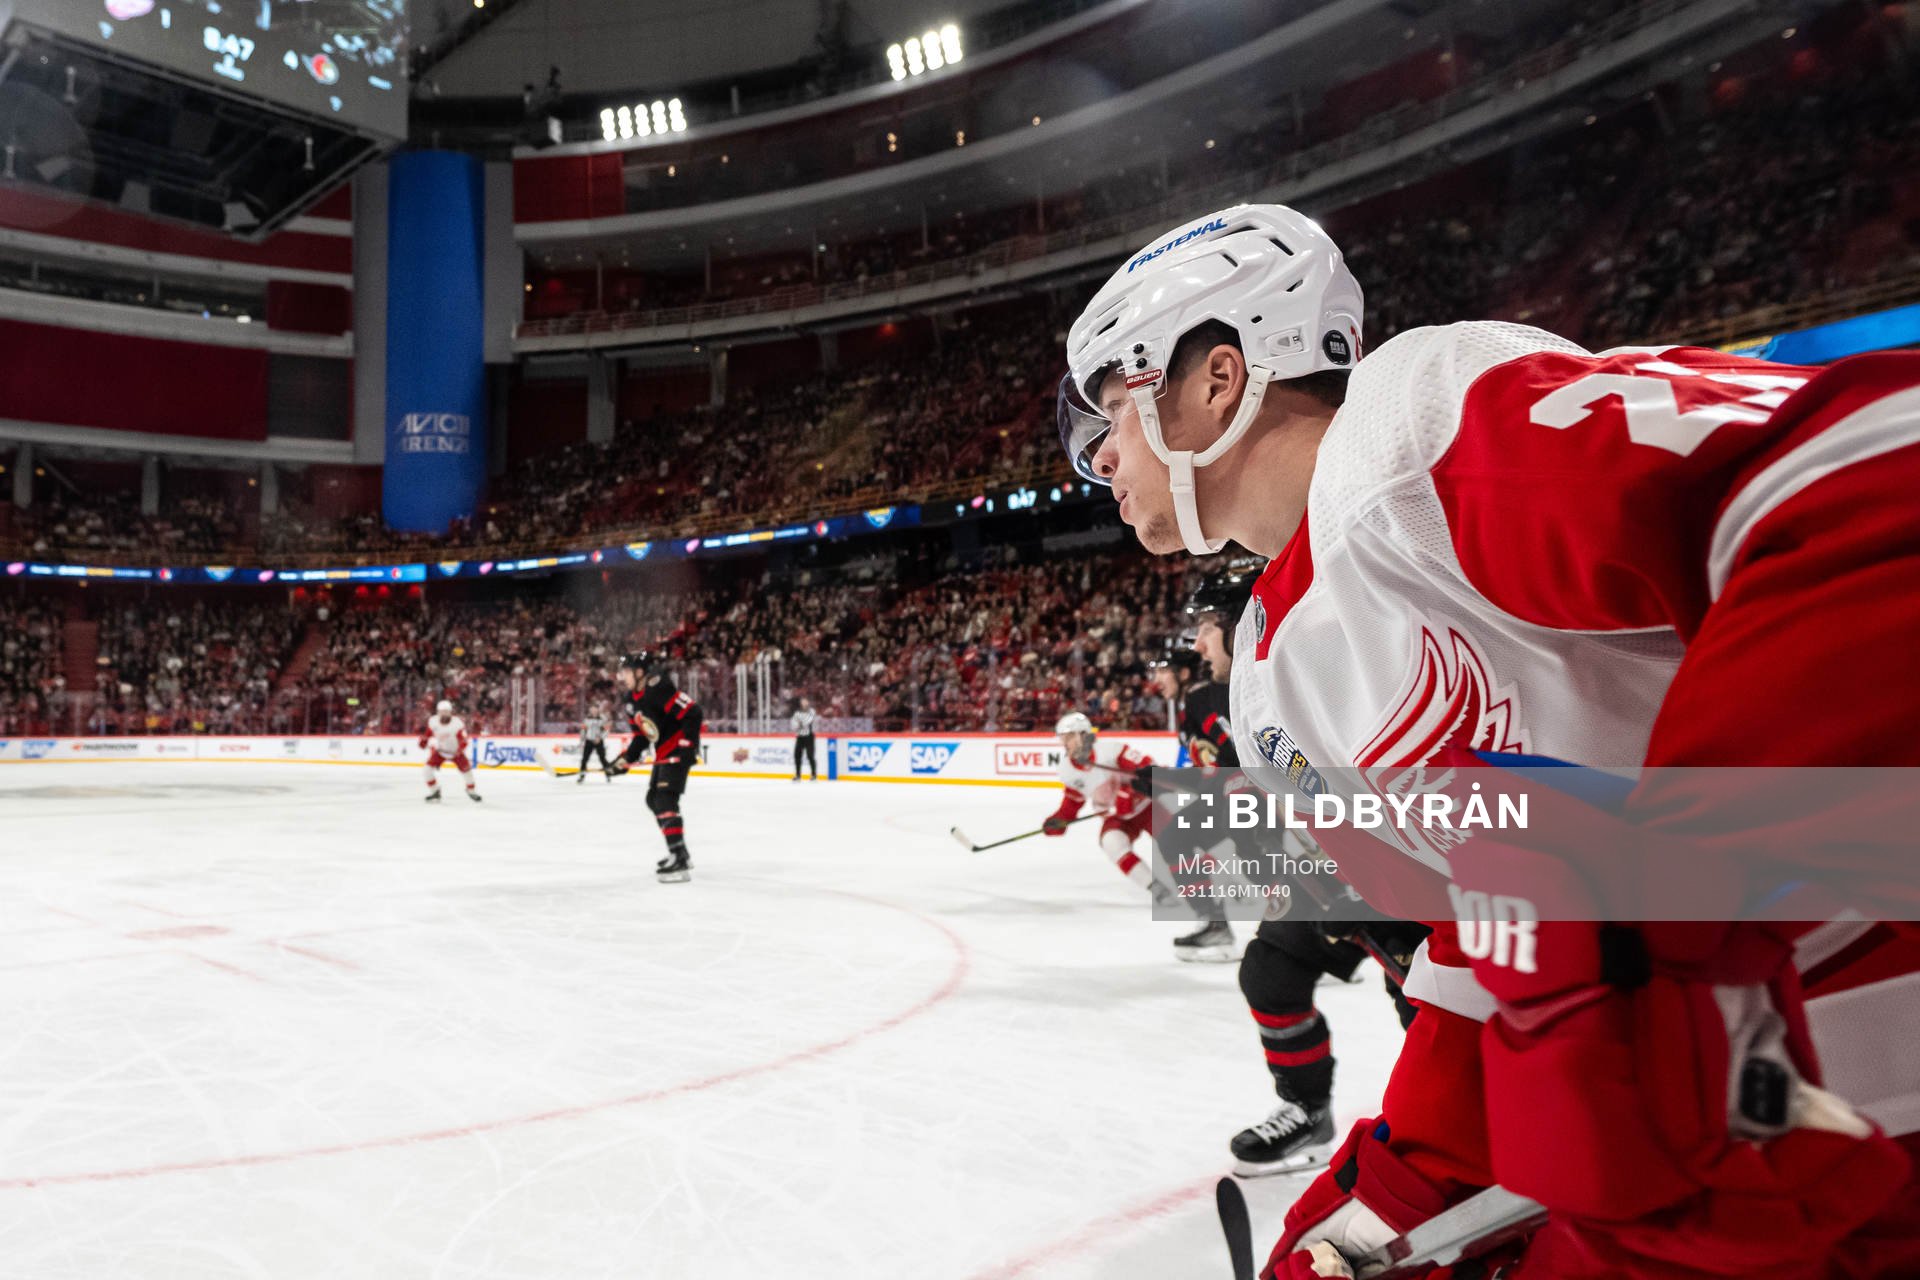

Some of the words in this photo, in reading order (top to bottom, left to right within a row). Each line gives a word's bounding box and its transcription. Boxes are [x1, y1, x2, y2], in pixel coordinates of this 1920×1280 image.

[1127, 217, 1228, 273] FASTENAL
[1126, 370, 1161, 384] BAUER
[484, 741, 537, 763] FASTENAL
[849, 746, 883, 768] SAP
[911, 746, 949, 769] SAP
[1003, 752, 1043, 767] LIVE
